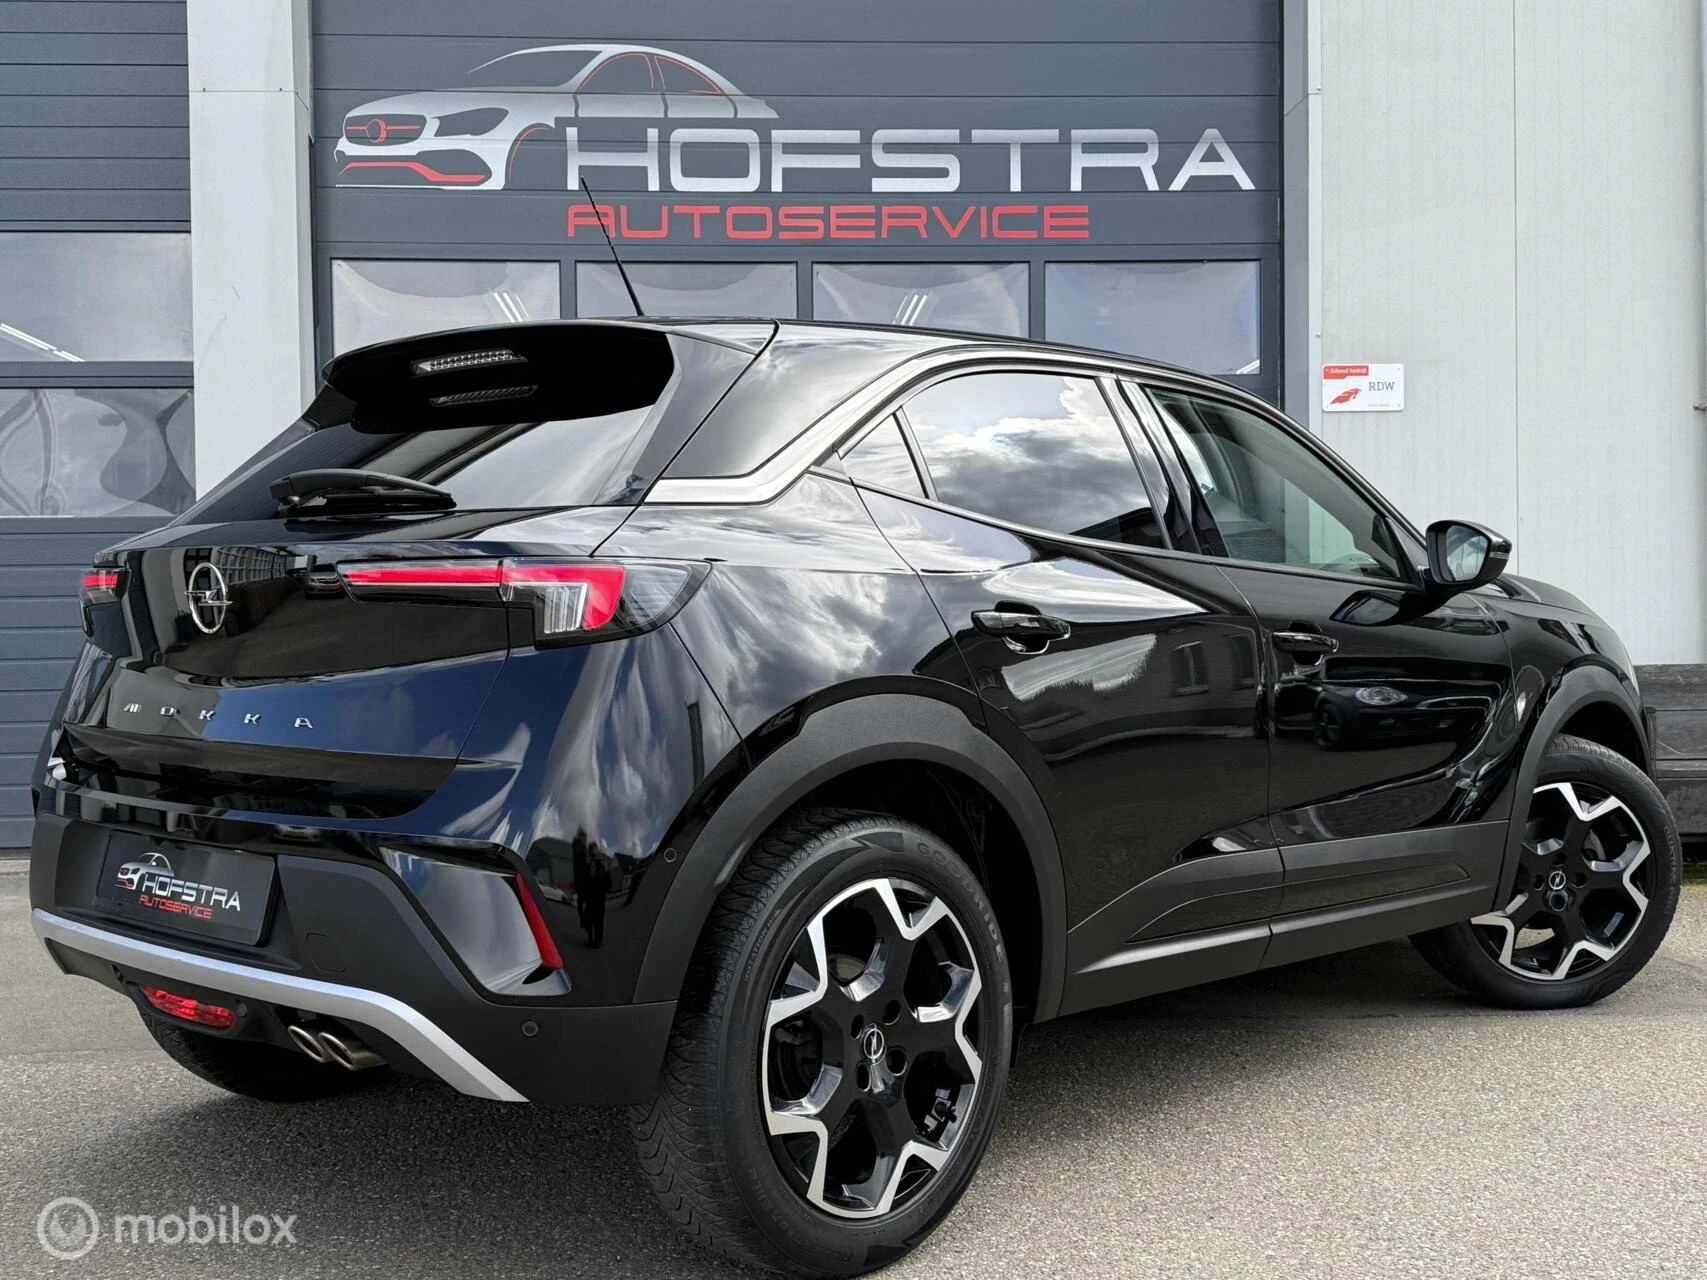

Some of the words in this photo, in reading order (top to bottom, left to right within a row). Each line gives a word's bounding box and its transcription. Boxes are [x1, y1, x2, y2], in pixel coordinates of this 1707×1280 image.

[567, 127, 1256, 193] HOFSTRA
[568, 204, 1090, 240] AUTOSERVICE
[1369, 381, 1395, 391] RDW
[123, 703, 313, 728] MOKKA
[139, 894, 213, 919] AUTOSERVICE
[142, 873, 240, 912] HOFSTRA
